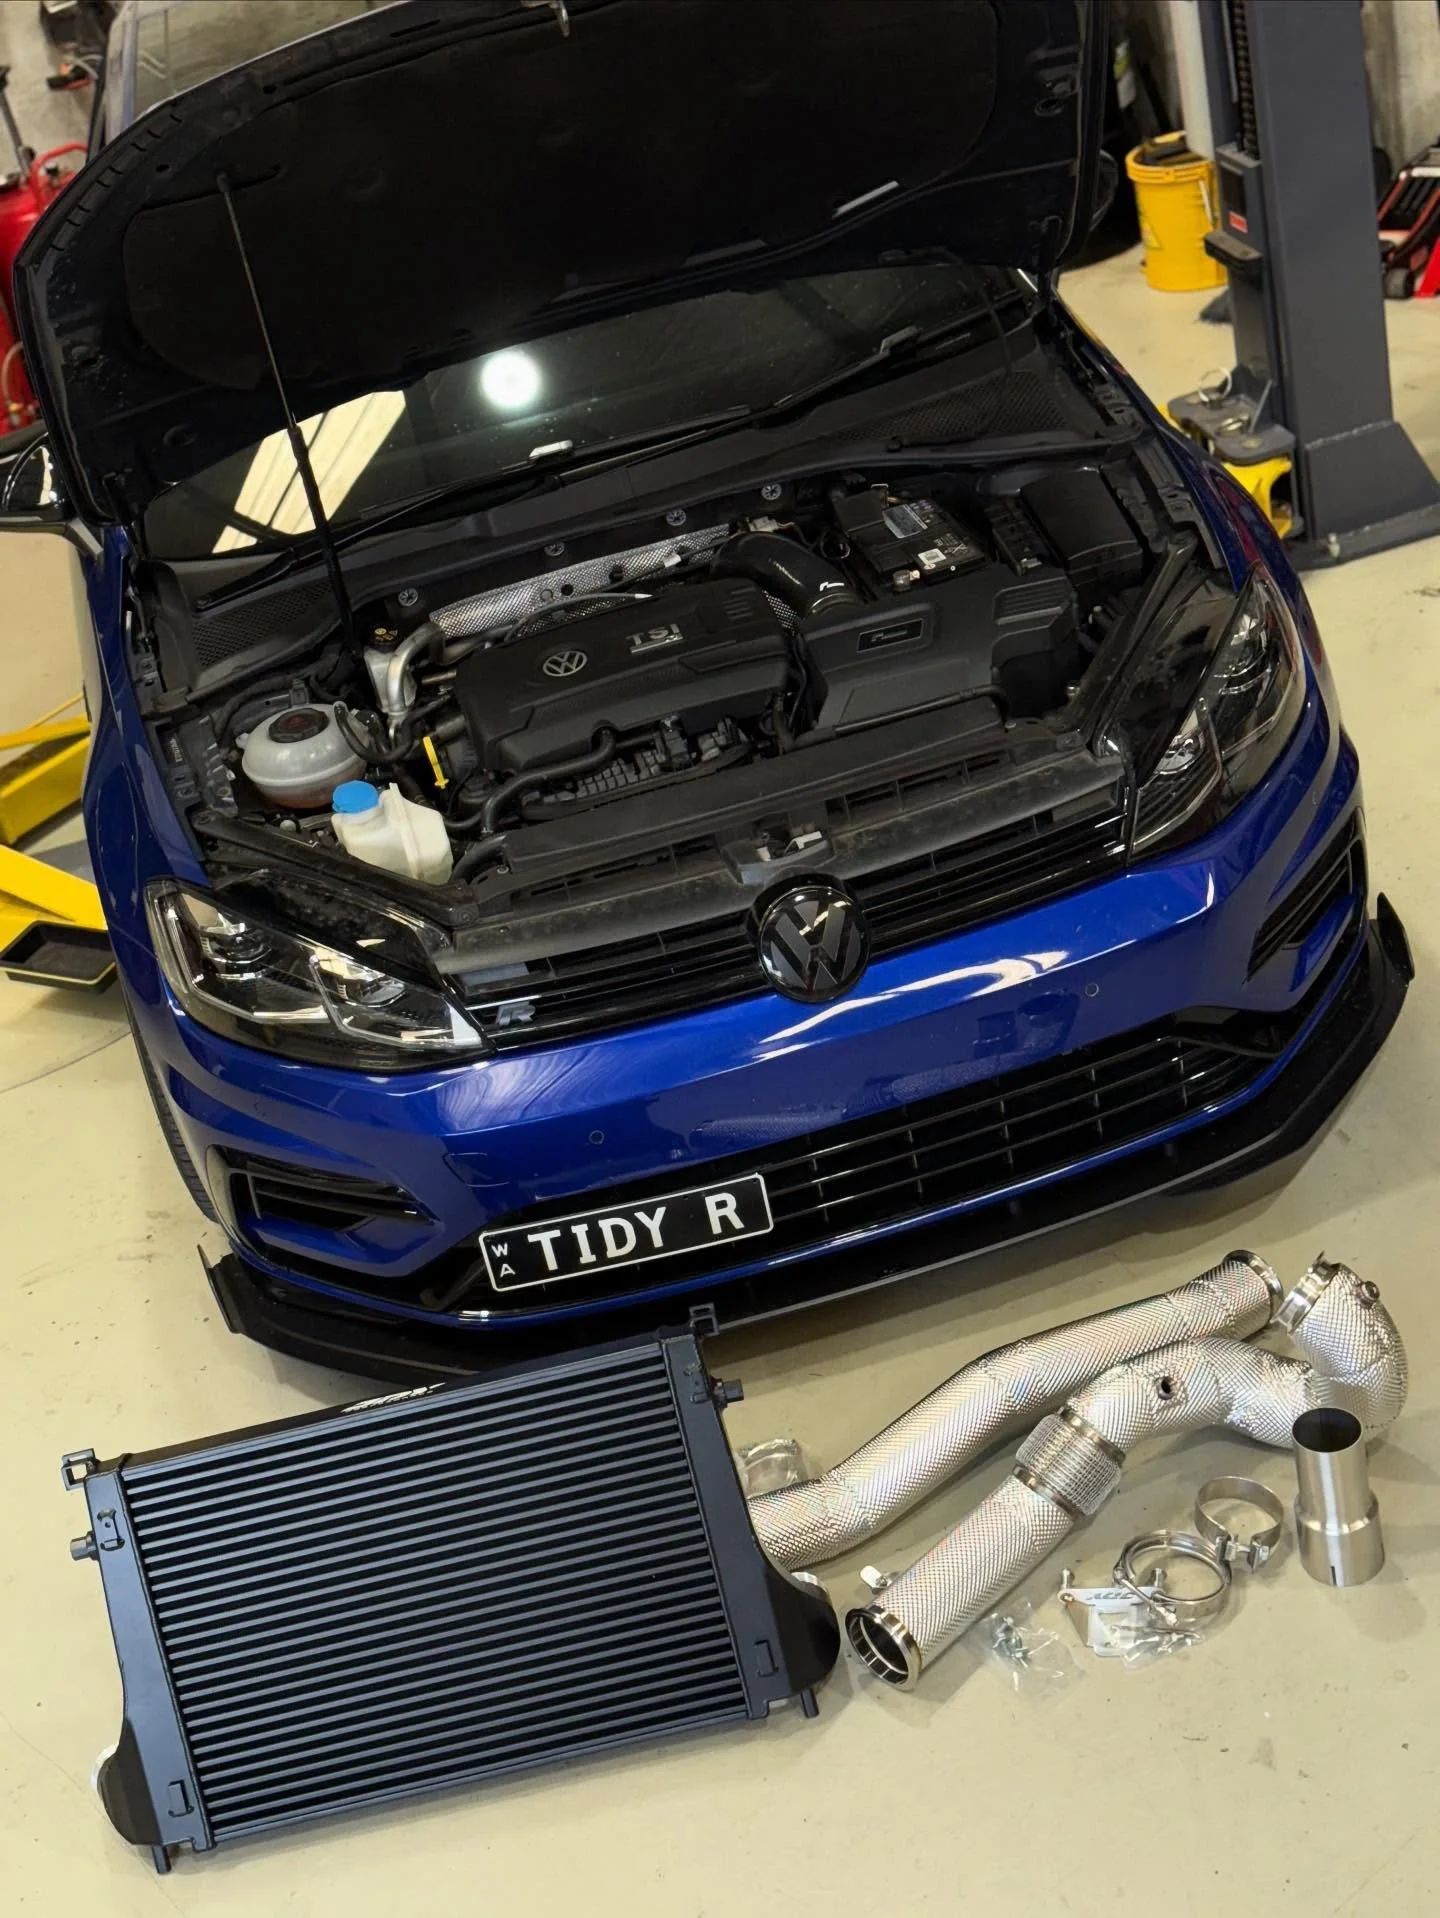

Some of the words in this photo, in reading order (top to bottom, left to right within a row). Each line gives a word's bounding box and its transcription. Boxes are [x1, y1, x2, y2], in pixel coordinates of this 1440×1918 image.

[625, 623, 681, 646] TSI
[527, 1206, 667, 1271] TIDY
[705, 1192, 745, 1235] R
